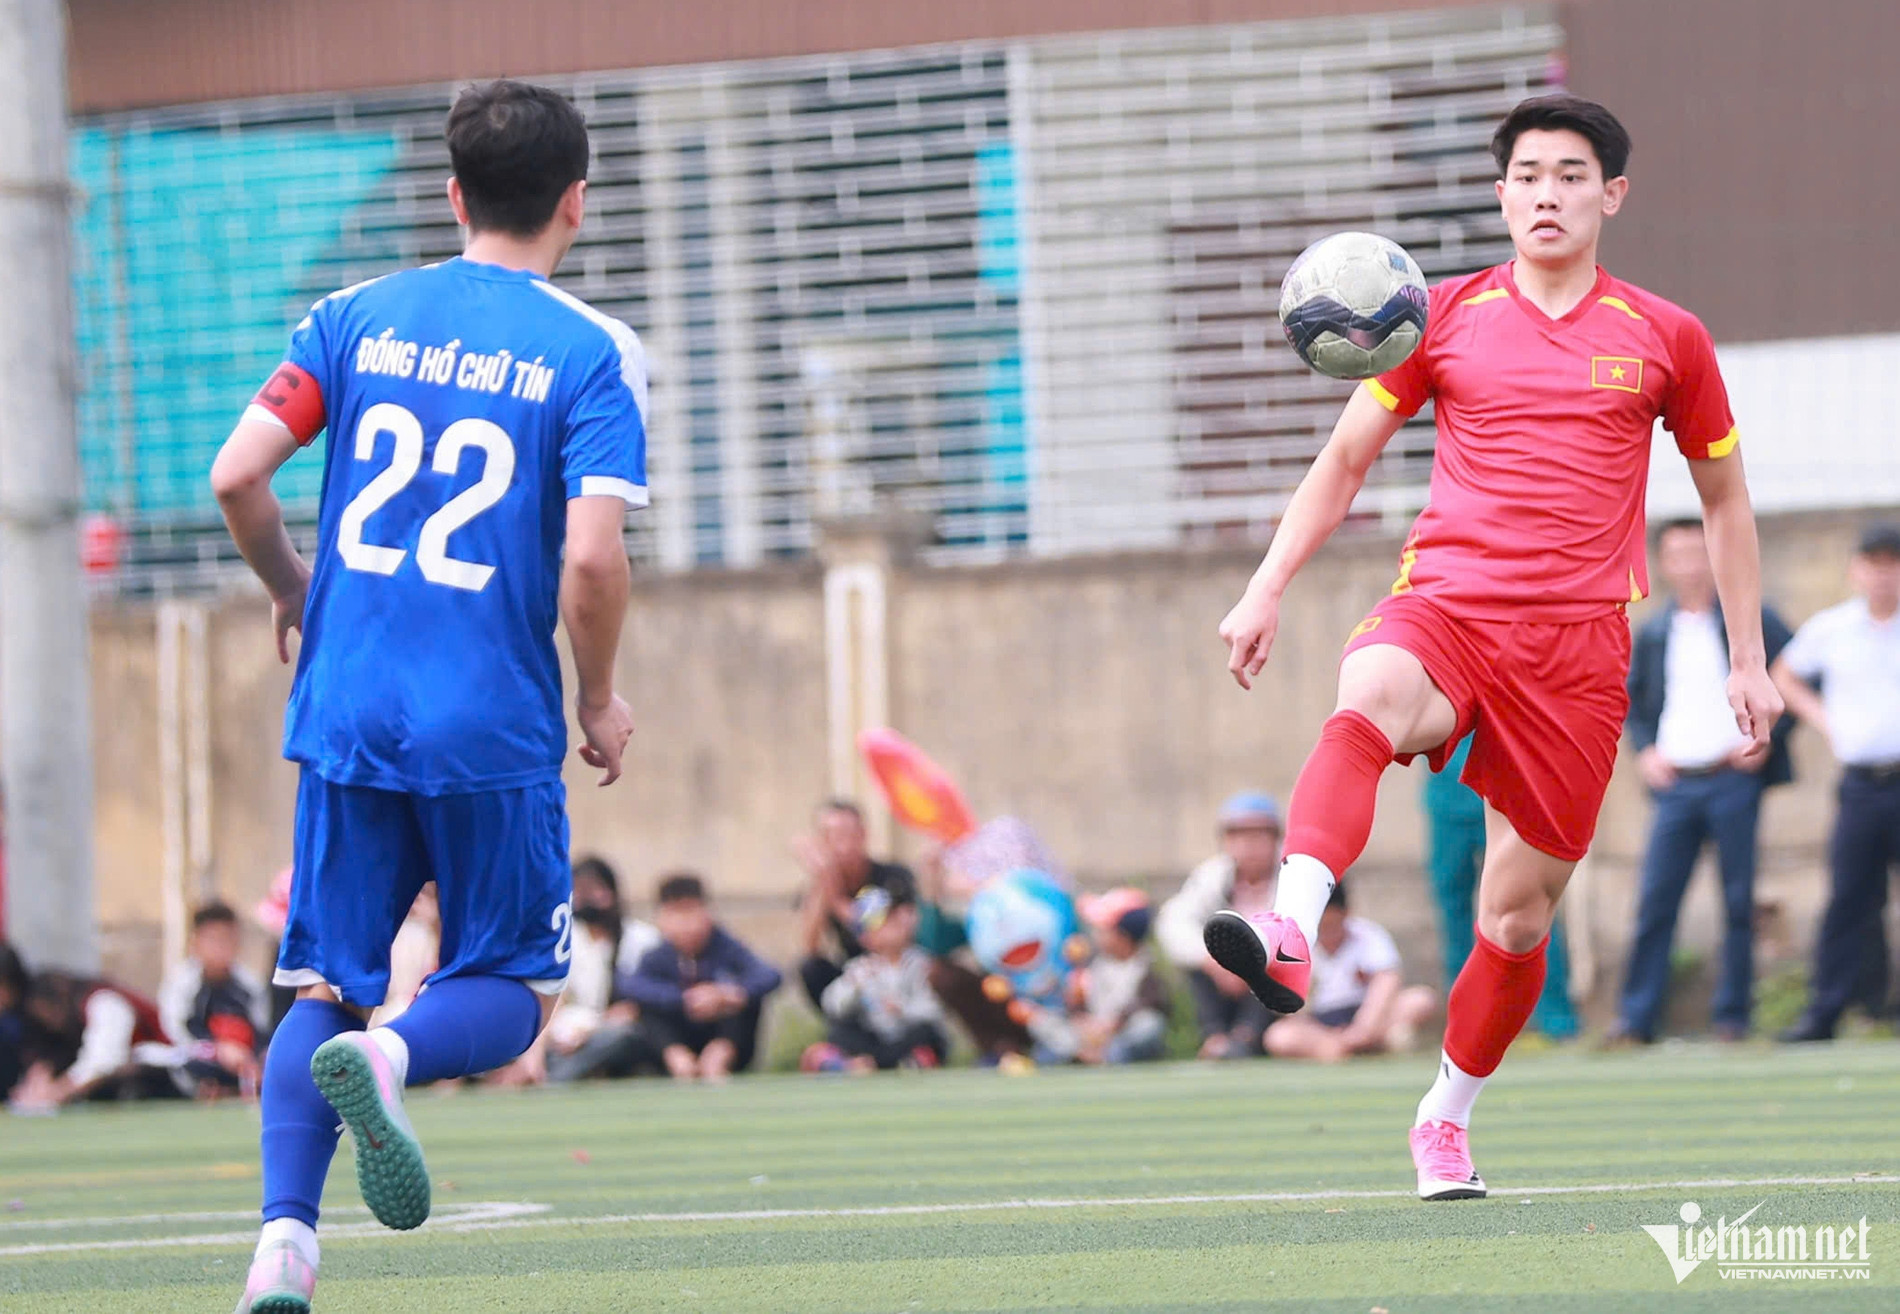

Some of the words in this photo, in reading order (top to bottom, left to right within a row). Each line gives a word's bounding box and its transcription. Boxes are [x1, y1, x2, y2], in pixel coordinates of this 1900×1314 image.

[260, 370, 300, 406] C
[511, 355, 554, 404] TÍN
[338, 403, 515, 592] 22
